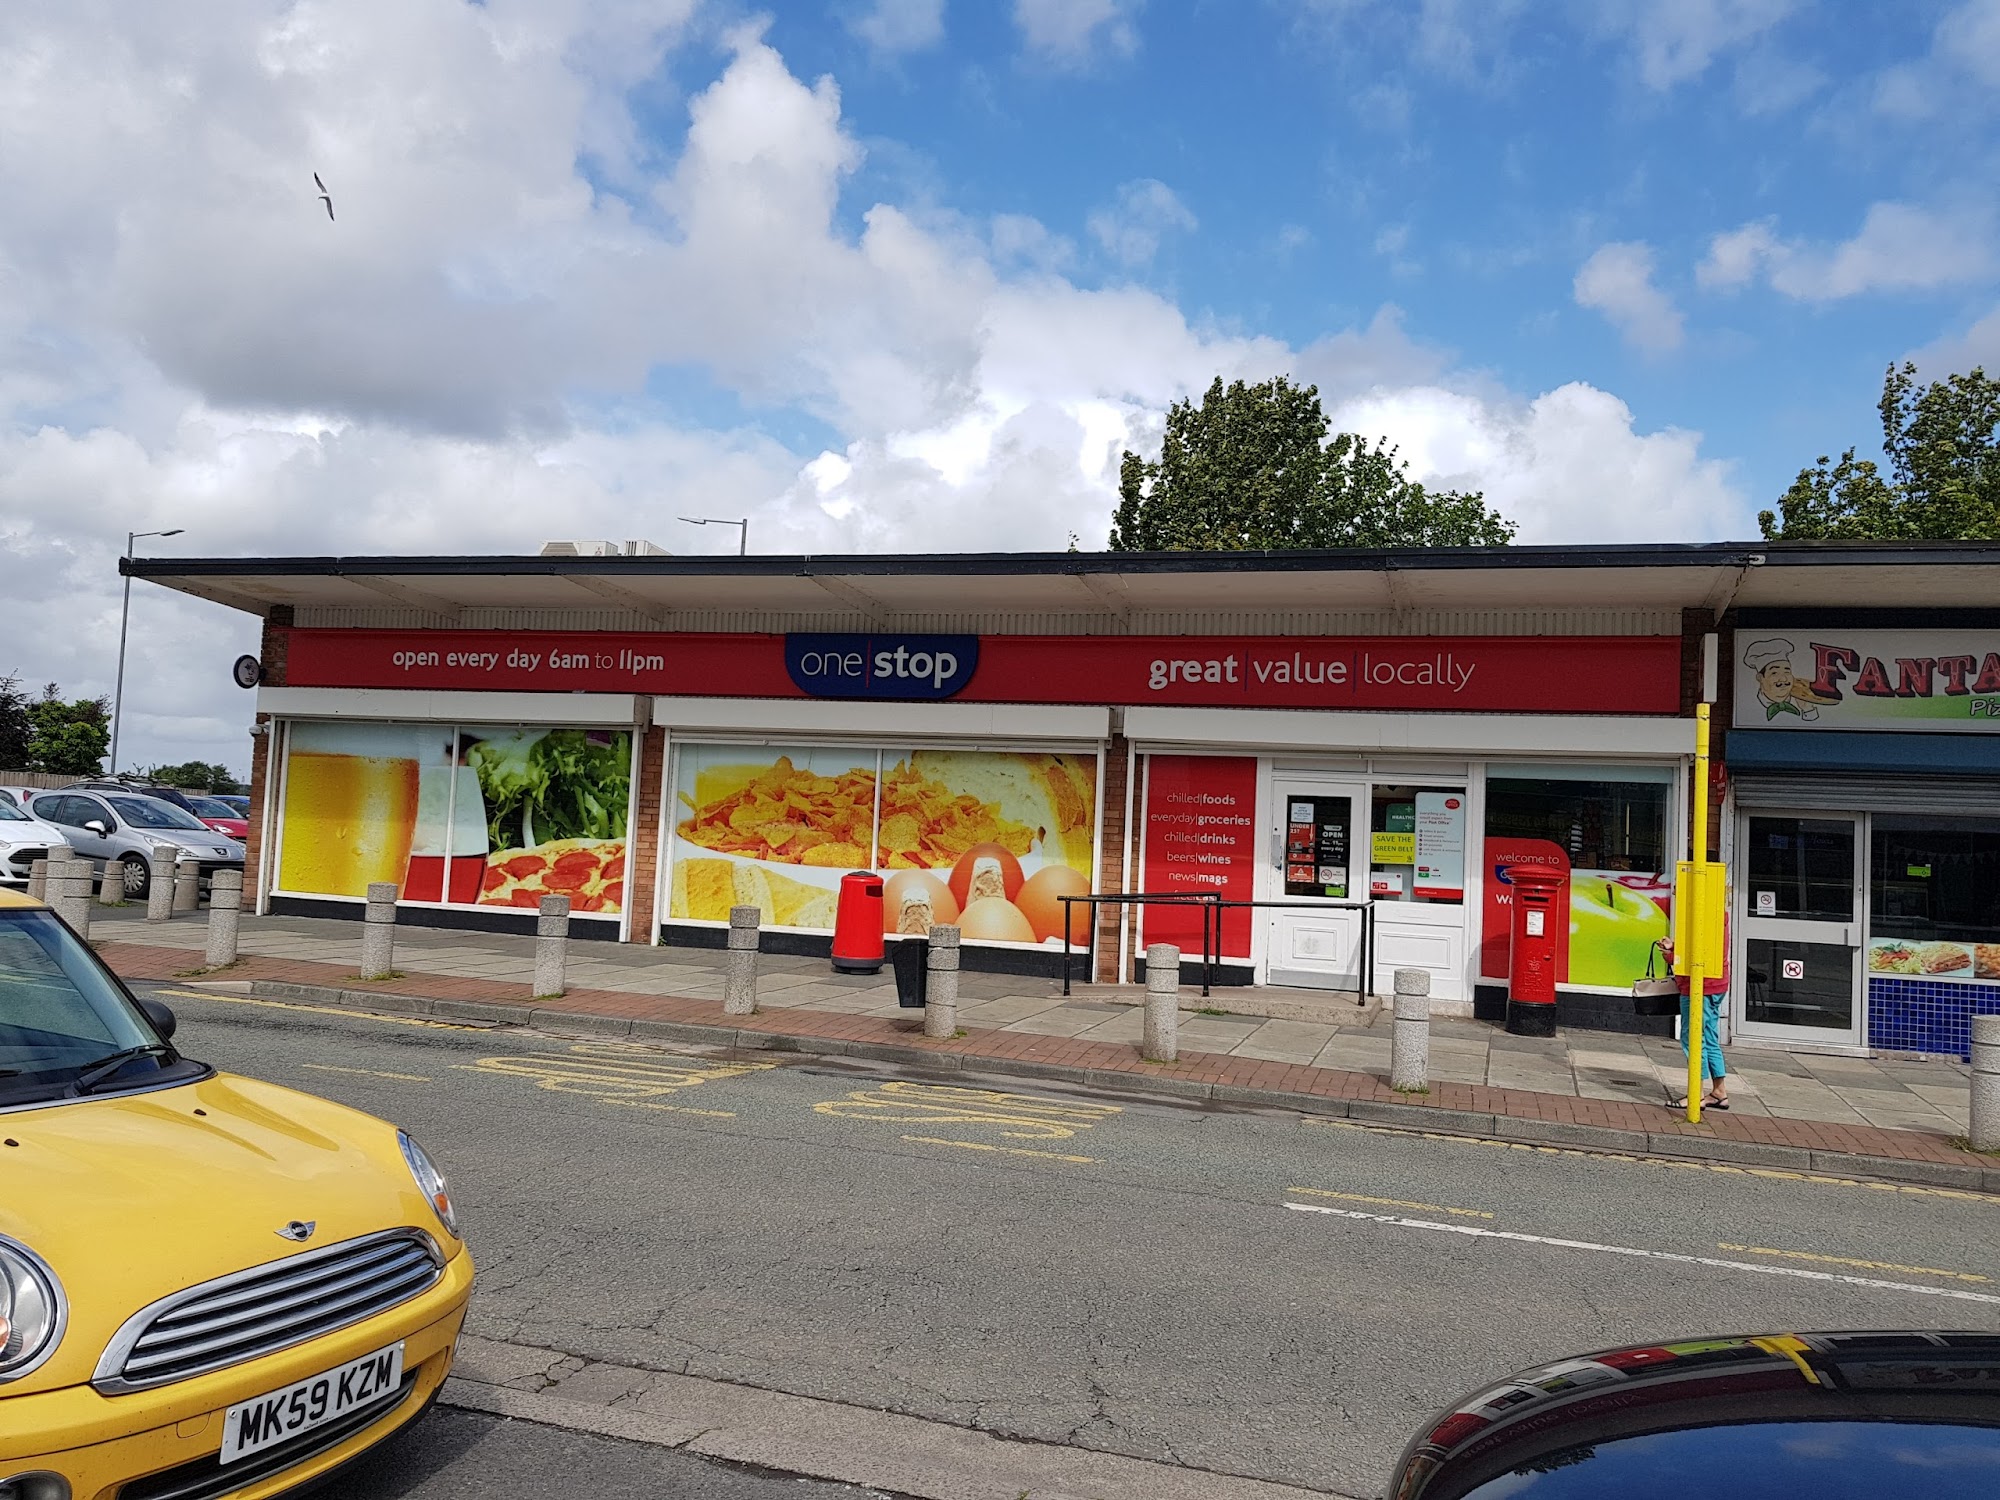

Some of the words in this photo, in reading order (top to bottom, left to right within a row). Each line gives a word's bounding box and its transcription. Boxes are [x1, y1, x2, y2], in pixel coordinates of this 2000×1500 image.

[392, 649, 439, 671] open
[446, 650, 498, 671] every
[506, 648, 542, 672] day
[548, 647, 591, 669] 6am
[594, 650, 613, 669] to
[619, 648, 665, 675] 11pm
[801, 652, 863, 677] one
[873, 645, 957, 689] stop
[1149, 653, 1239, 690] great
[1253, 652, 1347, 685] value
[1363, 652, 1476, 692] locally
[1495, 852, 1544, 864] welcome
[1548, 855, 1559, 865] to
[237, 1379, 330, 1451] MK59
[336, 1350, 394, 1410] KZM
